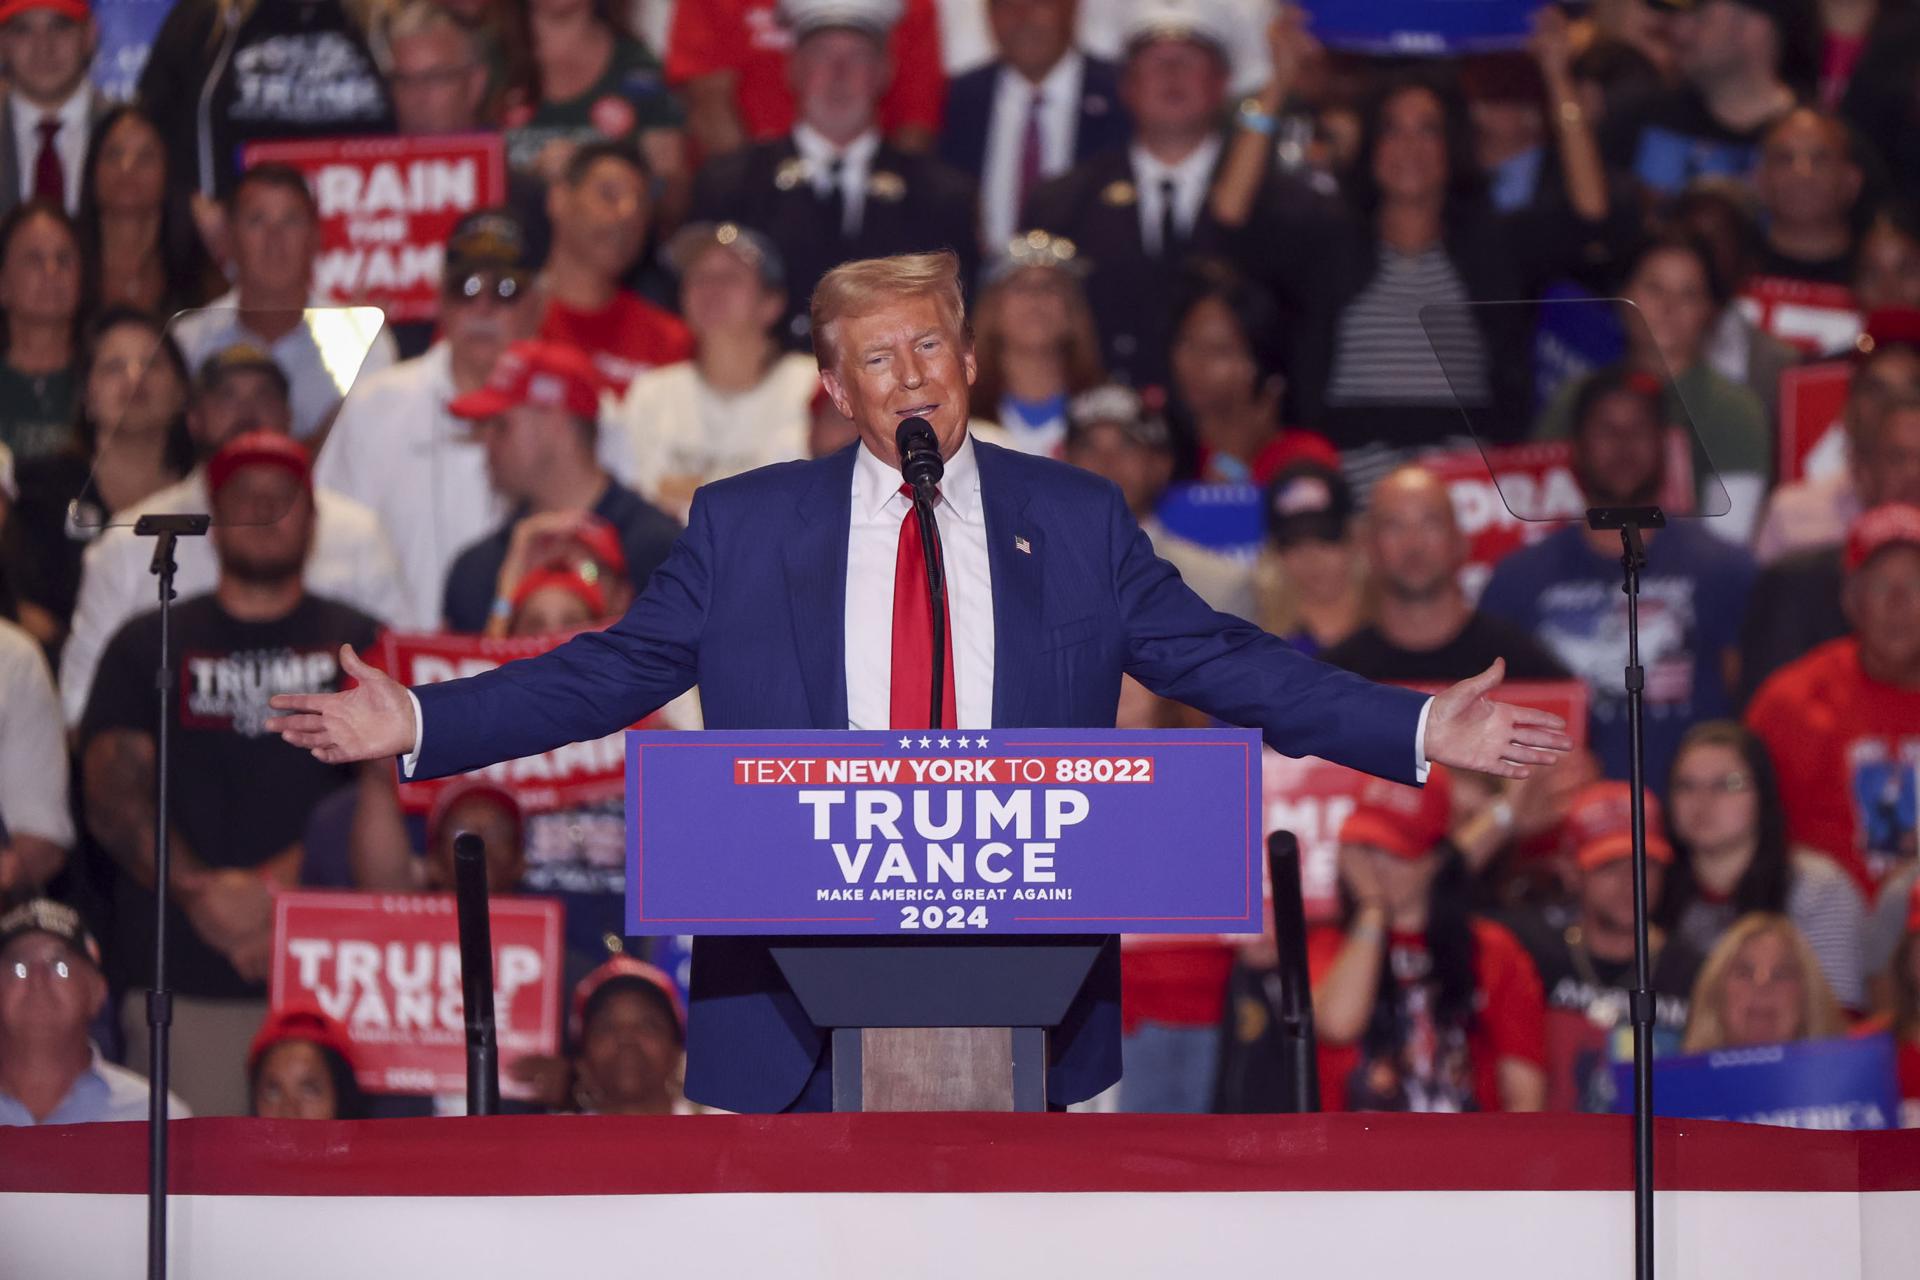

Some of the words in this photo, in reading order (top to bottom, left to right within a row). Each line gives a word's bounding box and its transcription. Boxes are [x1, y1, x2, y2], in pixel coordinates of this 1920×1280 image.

[312, 158, 477, 217] RAIN
[311, 246, 442, 289] WAM
[1450, 471, 1586, 535] DRA
[188, 651, 336, 696] TRUMP
[737, 760, 816, 783] TEXT
[826, 759, 900, 783] NEW
[909, 759, 997, 783] YORK
[1004, 759, 1046, 783] TO
[1055, 758, 1151, 782] 88022
[798, 789, 1090, 841] TRUMP
[831, 842, 1056, 884] VANCE
[816, 888, 864, 901] MAKE
[869, 888, 946, 901] AMERICA
[951, 888, 1007, 901] GREAT
[1012, 888, 1073, 900] AGAIN!
[899, 905, 989, 929] 2024
